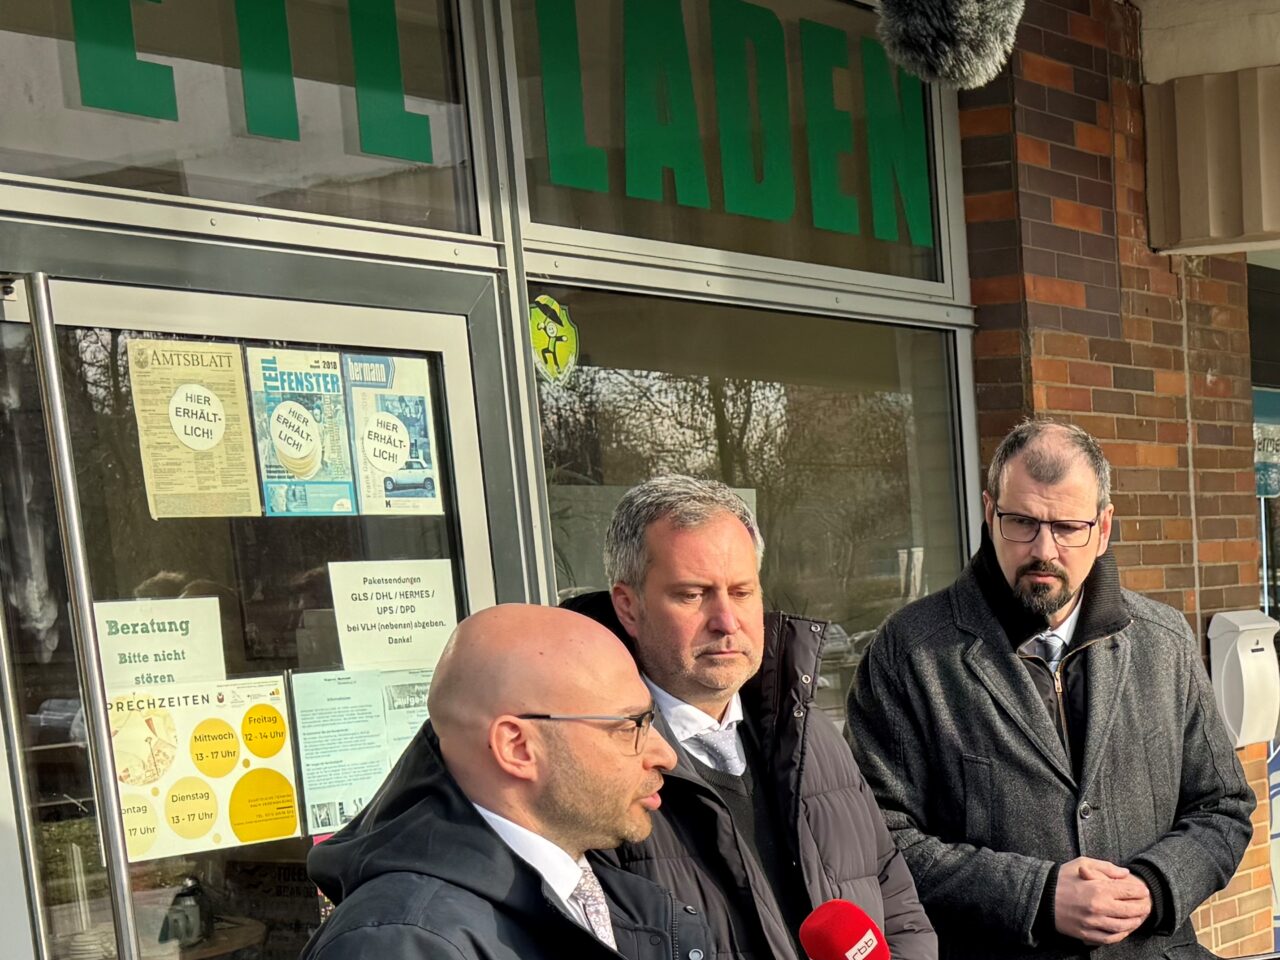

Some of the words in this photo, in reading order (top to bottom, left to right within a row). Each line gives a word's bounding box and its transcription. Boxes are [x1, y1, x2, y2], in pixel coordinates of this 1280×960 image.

[535, 0, 934, 248] LADEN
[151, 350, 233, 368] AMTSBLATT
[279, 370, 341, 393] FENSTER
[185, 393, 211, 406] HIER
[175, 406, 222, 423] ERHÄLT-
[288, 407, 309, 427] HIER
[184, 425, 213, 440] LICH!
[276, 414, 313, 443] ERHÄLT-
[376, 418, 399, 434] HIER
[278, 430, 303, 452] LICH!
[367, 430, 406, 450] ERHÄLT-
[373, 447, 398, 464] LICH!
[363, 577, 421, 585] Paketsendungen
[351, 592, 369, 601] GLS
[375, 592, 393, 600] DHL
[399, 590, 430, 599] HERMES
[377, 606, 394, 615] UPS
[400, 605, 416, 614] DPD
[106, 618, 190, 637] Beratung
[347, 623, 359, 632] bei
[360, 623, 377, 631] VLH
[388, 636, 412, 644] Danke!
[118, 651, 150, 664] Bitte
[154, 650, 186, 661] nicht
[134, 673, 175, 685] stören
[248, 715, 277, 725] Freitag
[194, 731, 234, 743] Mittwoch
[244, 733, 253, 742] 12
[259, 731, 268, 740] 14
[269, 730, 285, 739] Uhr
[195, 752, 204, 761] 13
[211, 751, 220, 760] 17
[221, 749, 236, 759] Uhr
[171, 791, 210, 803] Dienstag
[171, 815, 180, 824] 13
[187, 813, 196, 822] 17
[198, 812, 214, 821] Uhr
[128, 827, 138, 837] 17
[139, 826, 156, 836] Uhr
